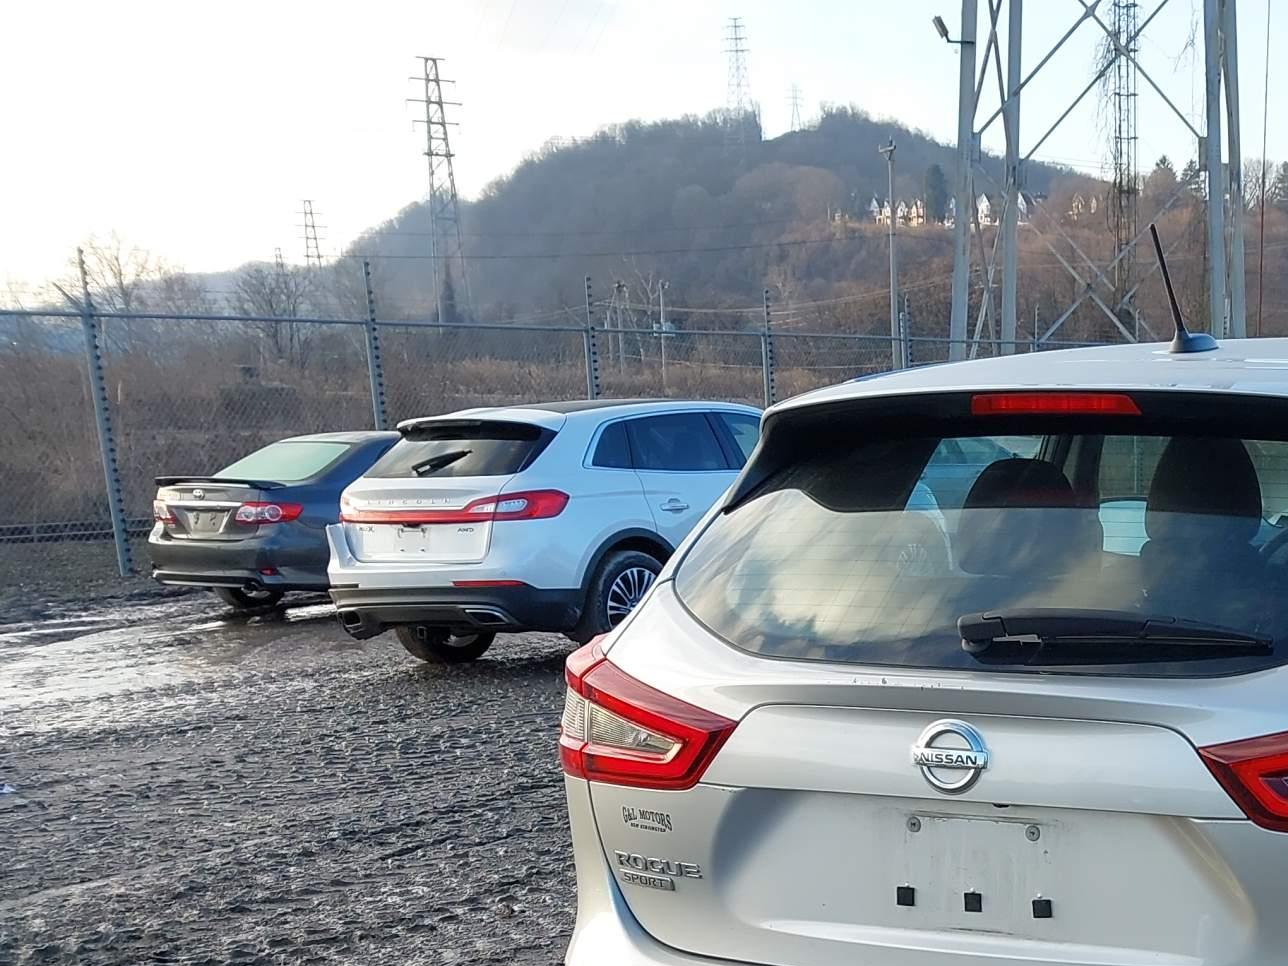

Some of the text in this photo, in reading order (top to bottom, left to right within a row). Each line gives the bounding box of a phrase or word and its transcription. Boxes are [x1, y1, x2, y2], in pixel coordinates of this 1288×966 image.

[920, 751, 978, 766] NISSAN
[639, 808, 673, 832] MOTORS
[614, 849, 703, 879] ROGUE
[623, 871, 666, 889] SPORT
